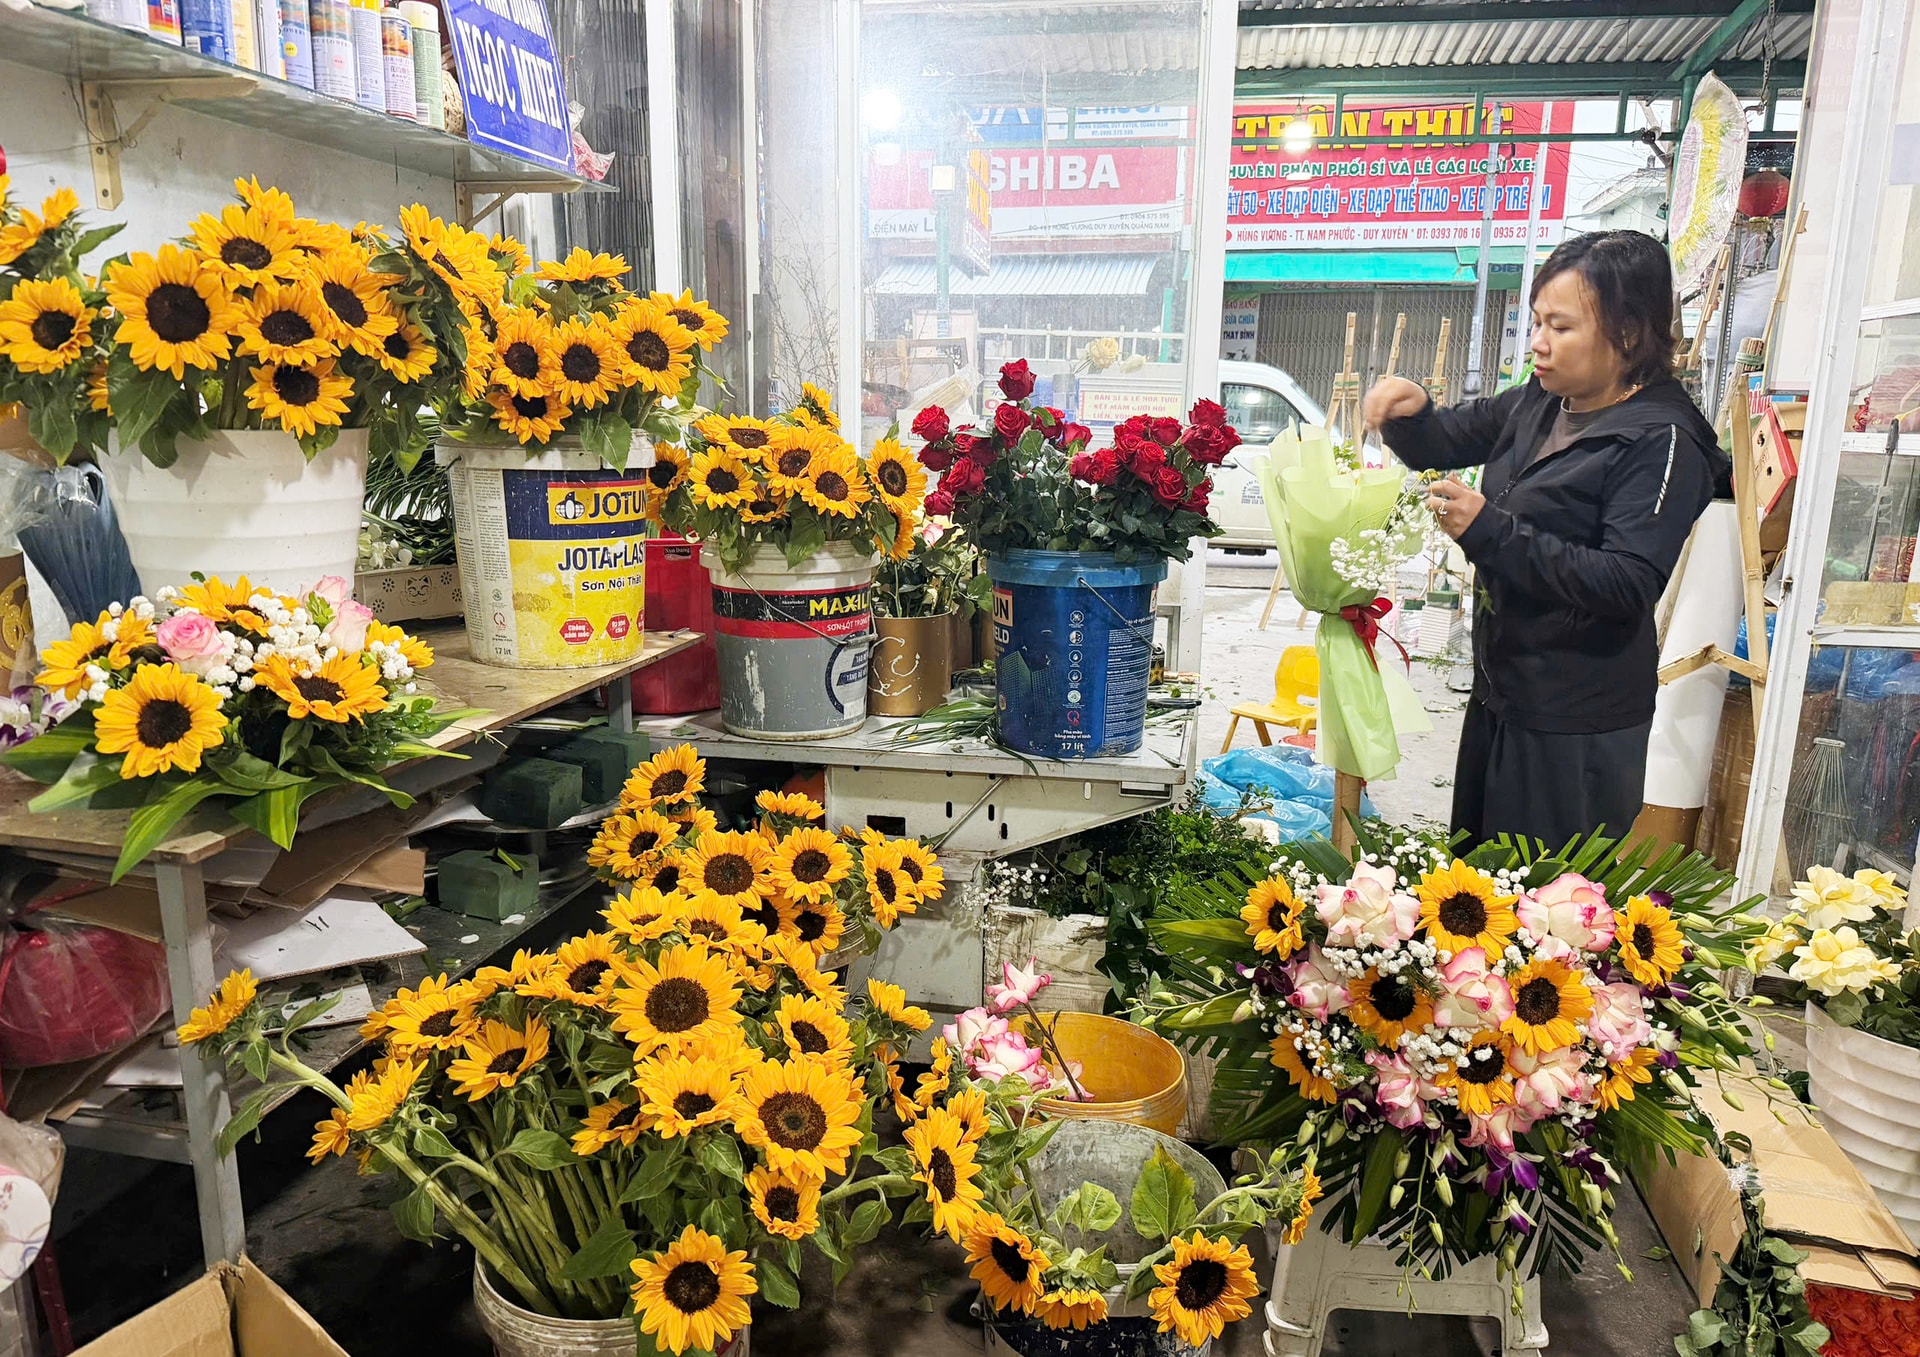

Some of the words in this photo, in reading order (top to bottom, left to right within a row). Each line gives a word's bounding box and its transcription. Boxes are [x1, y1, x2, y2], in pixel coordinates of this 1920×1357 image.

[456, 18, 516, 126] NGỌC
[510, 44, 563, 131] MINH
[1327, 157, 1365, 176] PHỐI
[1390, 158, 1410, 174] VÀ
[1436, 159, 1465, 173] CÁC
[1242, 192, 1258, 215] 50
[1267, 191, 1285, 215] XE
[1285, 190, 1309, 218] ĐẠP
[1311, 184, 1339, 217] ĐIỆN
[1350, 189, 1365, 214] XE
[1367, 188, 1392, 217] ĐẠP
[1419, 187, 1449, 211] THAO
[1460, 186, 1476, 211] XE
[1478, 186, 1503, 210] ĐP
[1506, 178, 1528, 210] TRẺ
[1237, 228, 1258, 242] HÙNG
[1307, 229, 1326, 241] NAM
[1363, 228, 1379, 240] DUY
[1431, 227, 1451, 239] 0393
[1453, 227, 1468, 239] 706
[1493, 227, 1514, 238] 0935
[557, 540, 645, 571] JOTAPLAS
[581, 581, 605, 592] Sơn
[608, 575, 626, 591] Nội
[1061, 742, 1072, 750] 17
